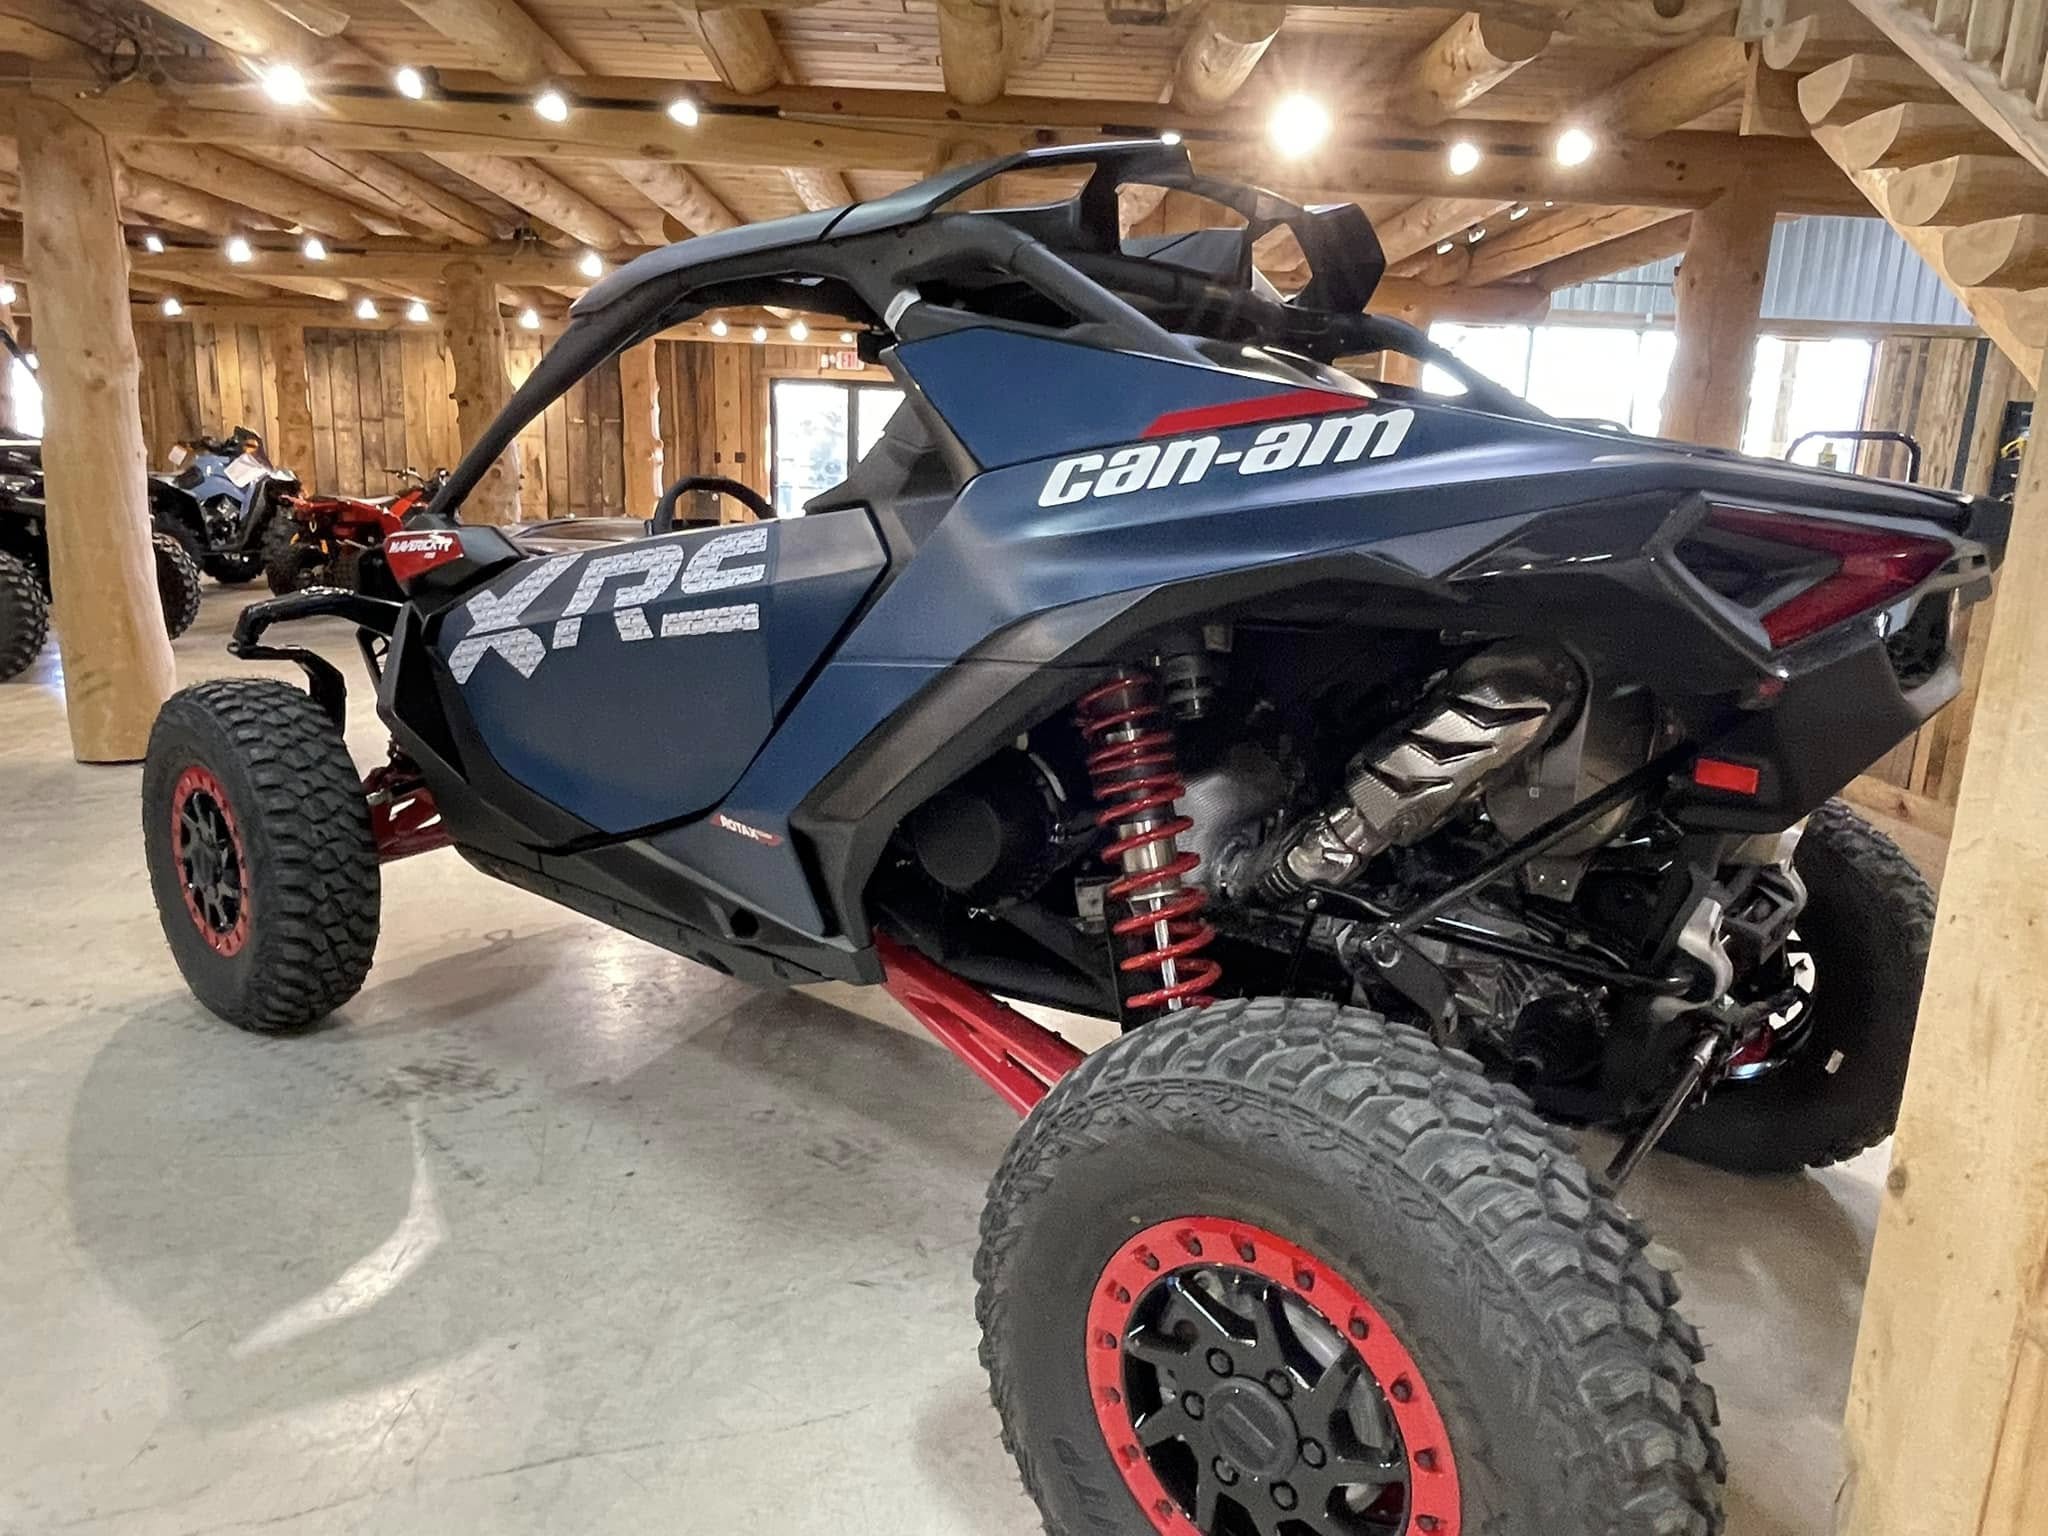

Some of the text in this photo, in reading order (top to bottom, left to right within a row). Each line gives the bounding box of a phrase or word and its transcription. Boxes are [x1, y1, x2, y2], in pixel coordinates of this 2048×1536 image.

[1038, 408, 1415, 508] can-am
[448, 528, 768, 685] XRS
[720, 814, 760, 841] ROTAX
